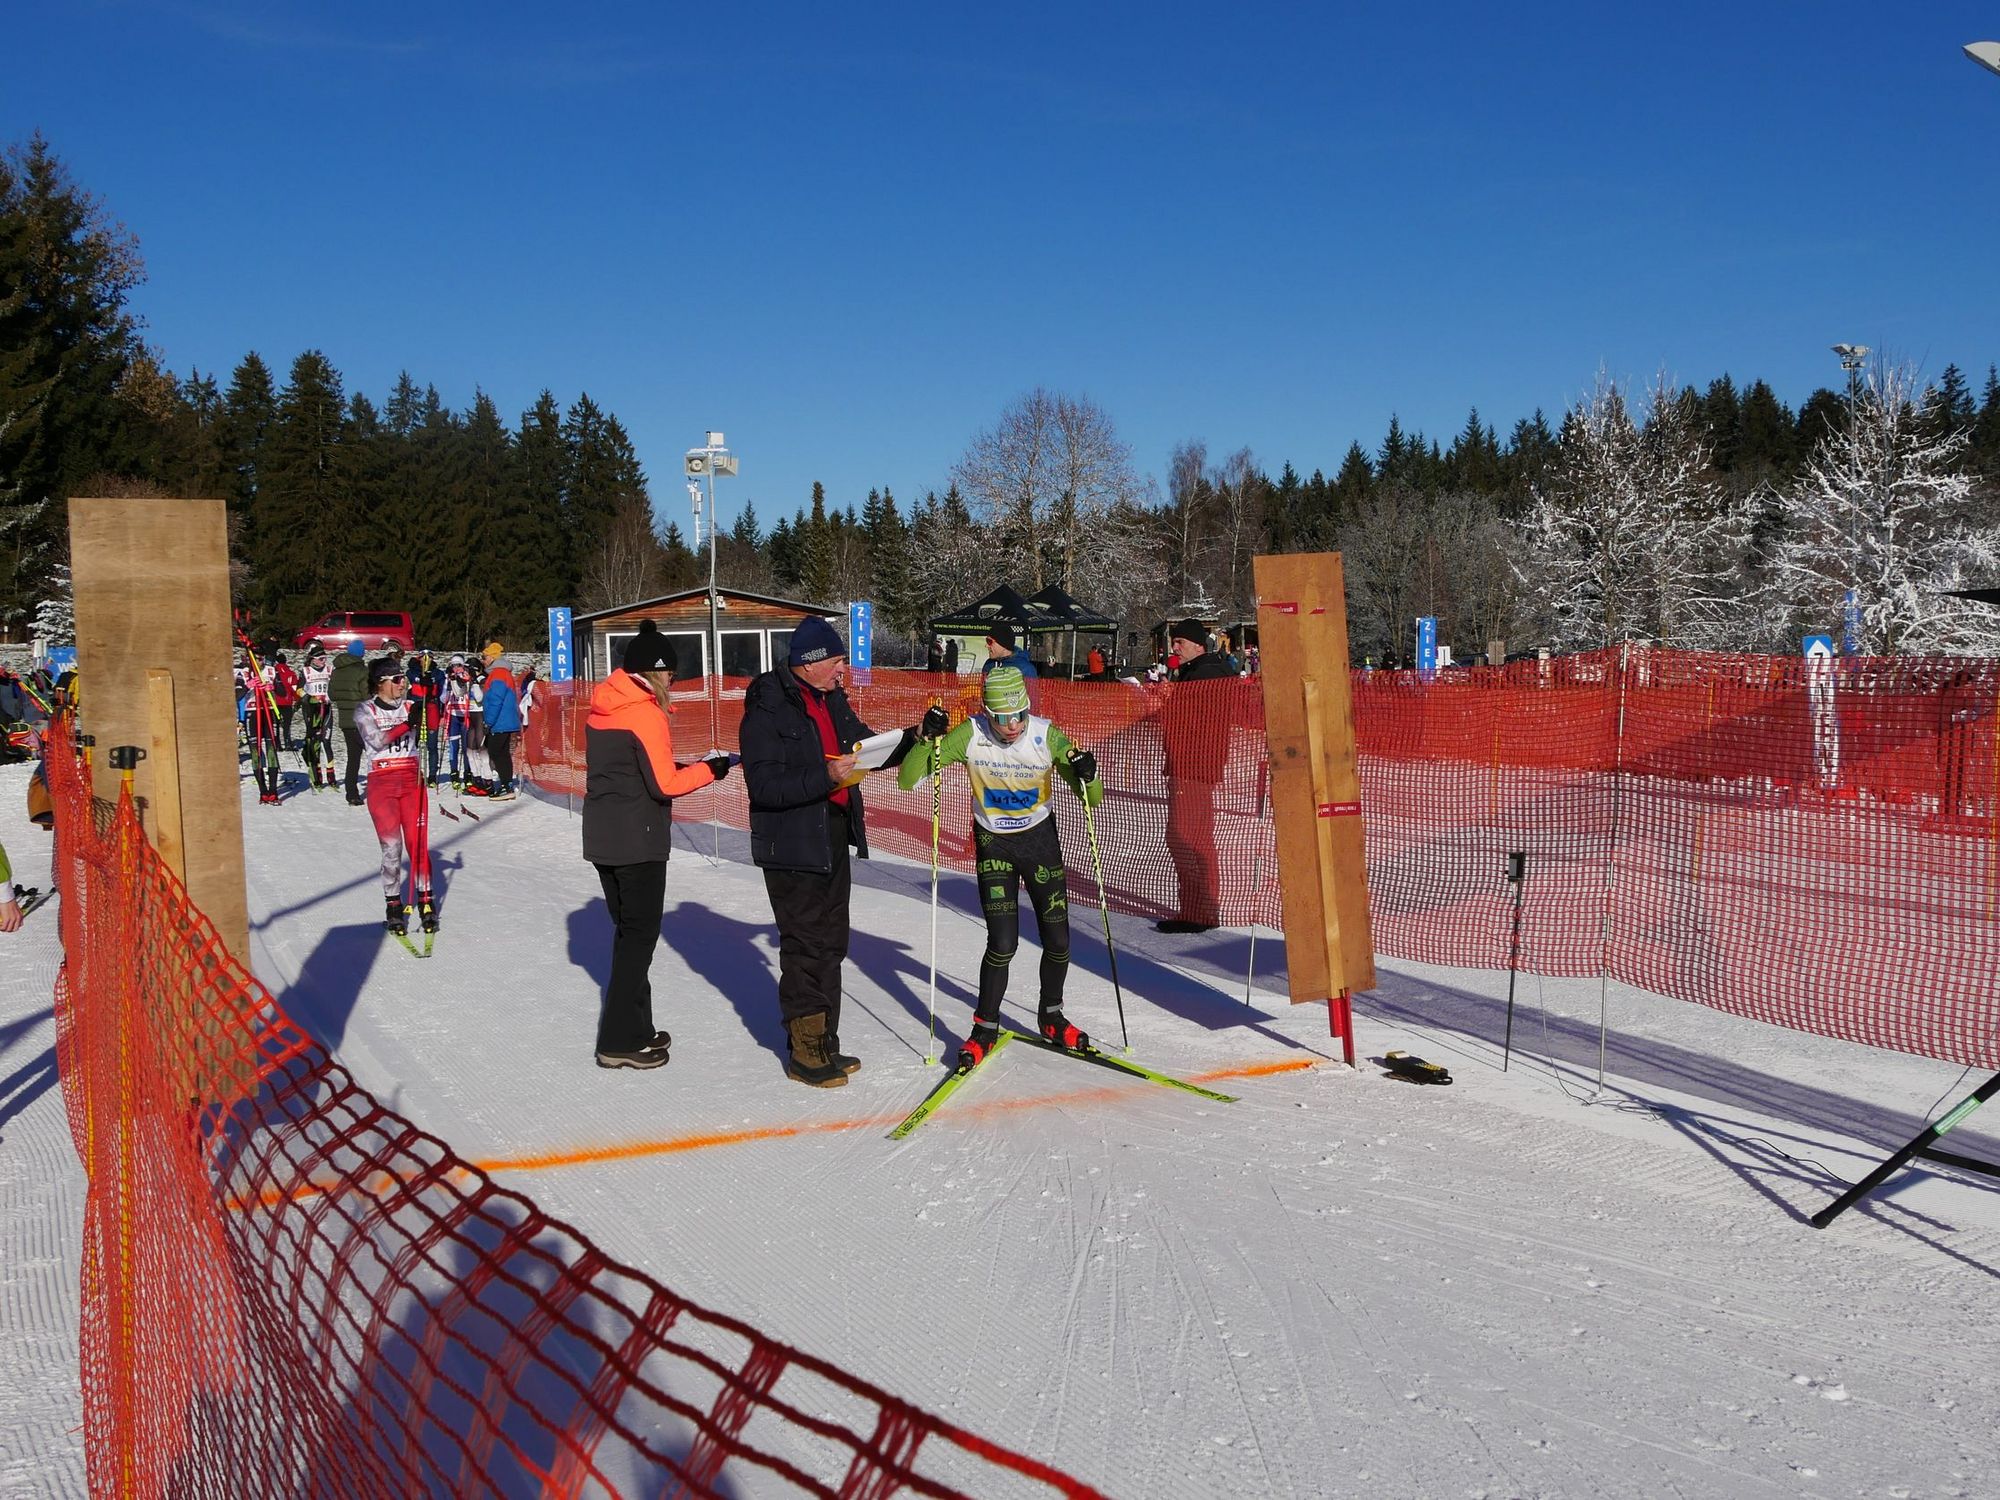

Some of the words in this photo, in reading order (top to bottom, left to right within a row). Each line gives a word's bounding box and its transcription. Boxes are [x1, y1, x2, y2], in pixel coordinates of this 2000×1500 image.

[556, 611, 567, 679] START
[857, 606, 865, 661] ZIEL
[990, 770, 1008, 778] 2025
